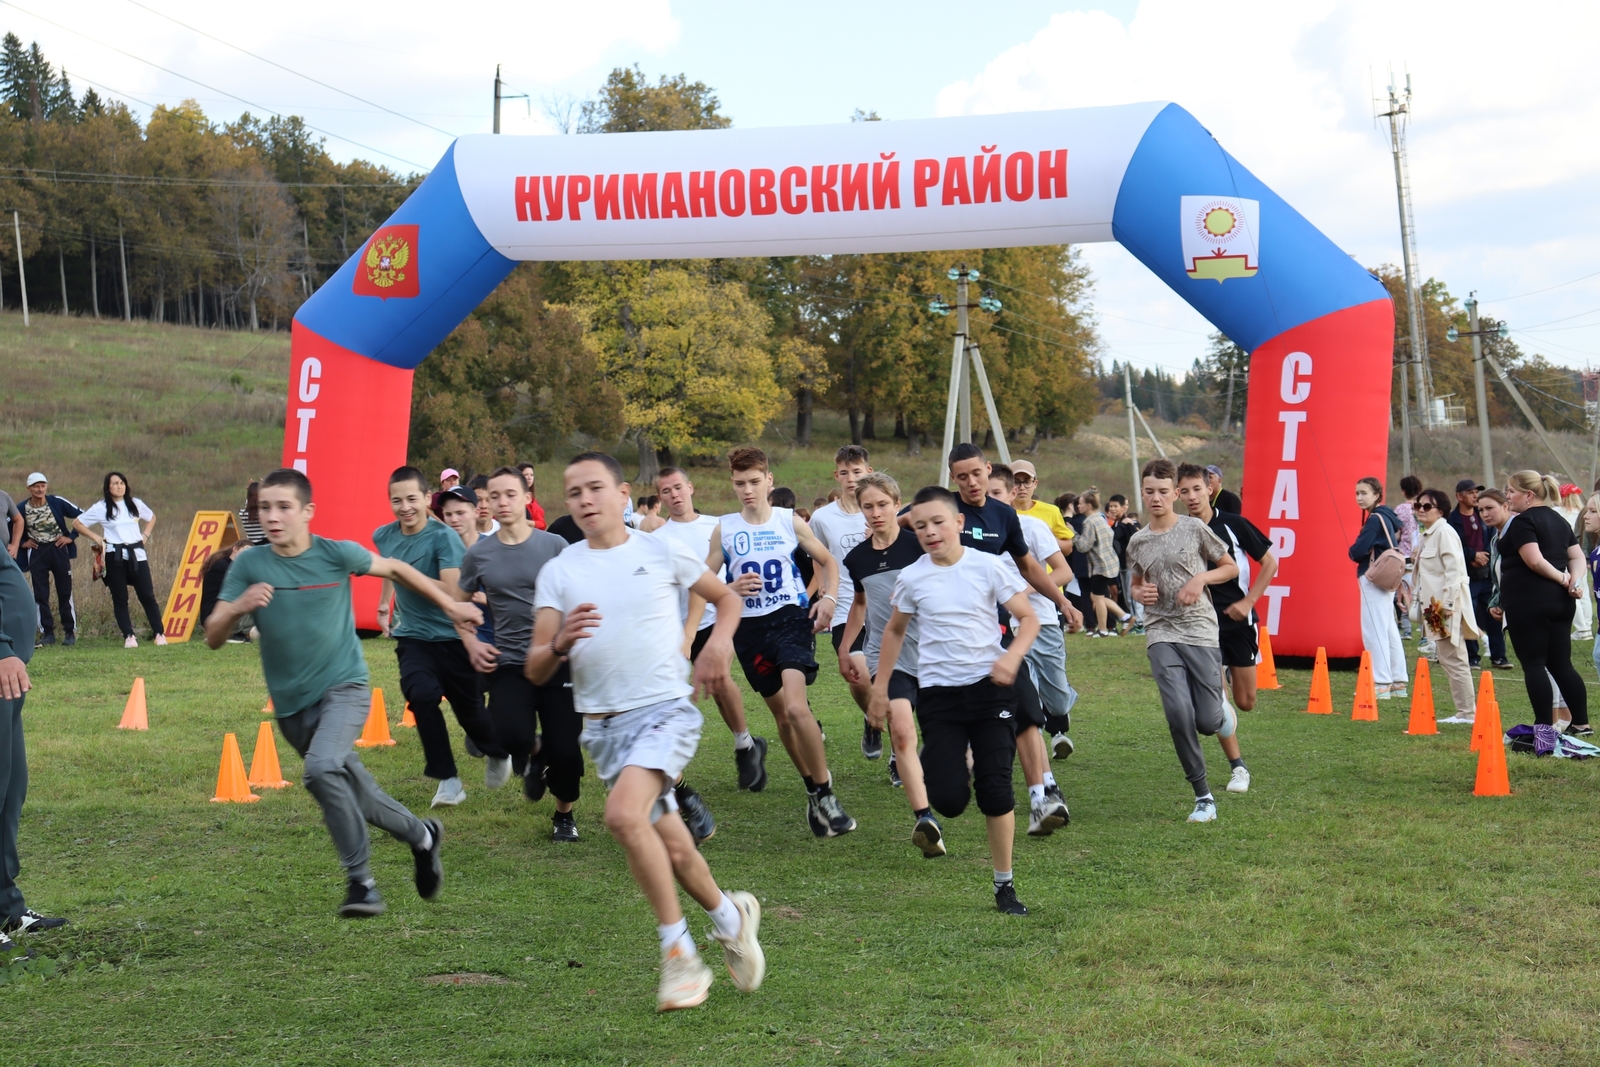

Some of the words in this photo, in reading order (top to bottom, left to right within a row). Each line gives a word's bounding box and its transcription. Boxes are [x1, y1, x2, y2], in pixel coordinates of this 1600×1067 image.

[515, 152, 901, 222] НУРИМАНОВСКИЙ
[913, 145, 1068, 207] РАЙОН
[1263, 351, 1313, 636] СТАРТ
[165, 521, 219, 637] ФИНИШ
[745, 597, 762, 609] ФА
